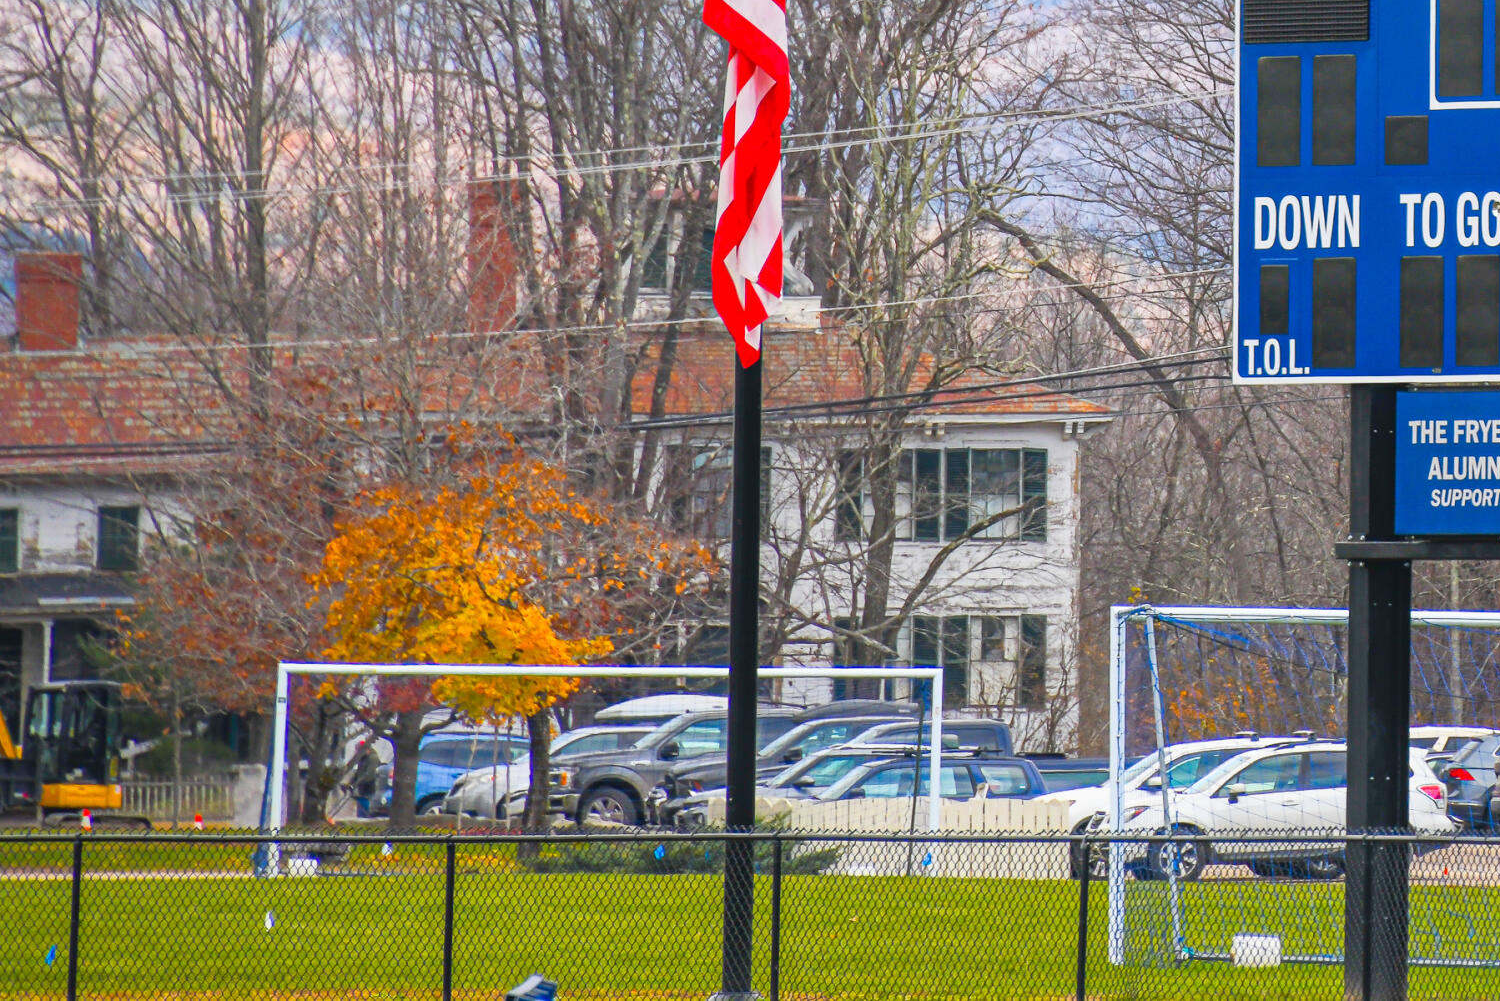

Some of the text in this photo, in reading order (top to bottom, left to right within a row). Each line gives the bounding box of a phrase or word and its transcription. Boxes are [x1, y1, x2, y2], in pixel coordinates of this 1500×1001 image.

[1254, 194, 1361, 250] DOWN
[1399, 192, 1446, 248] TO
[1243, 338, 1310, 376] T.O.L.
[1408, 420, 1448, 444] THE
